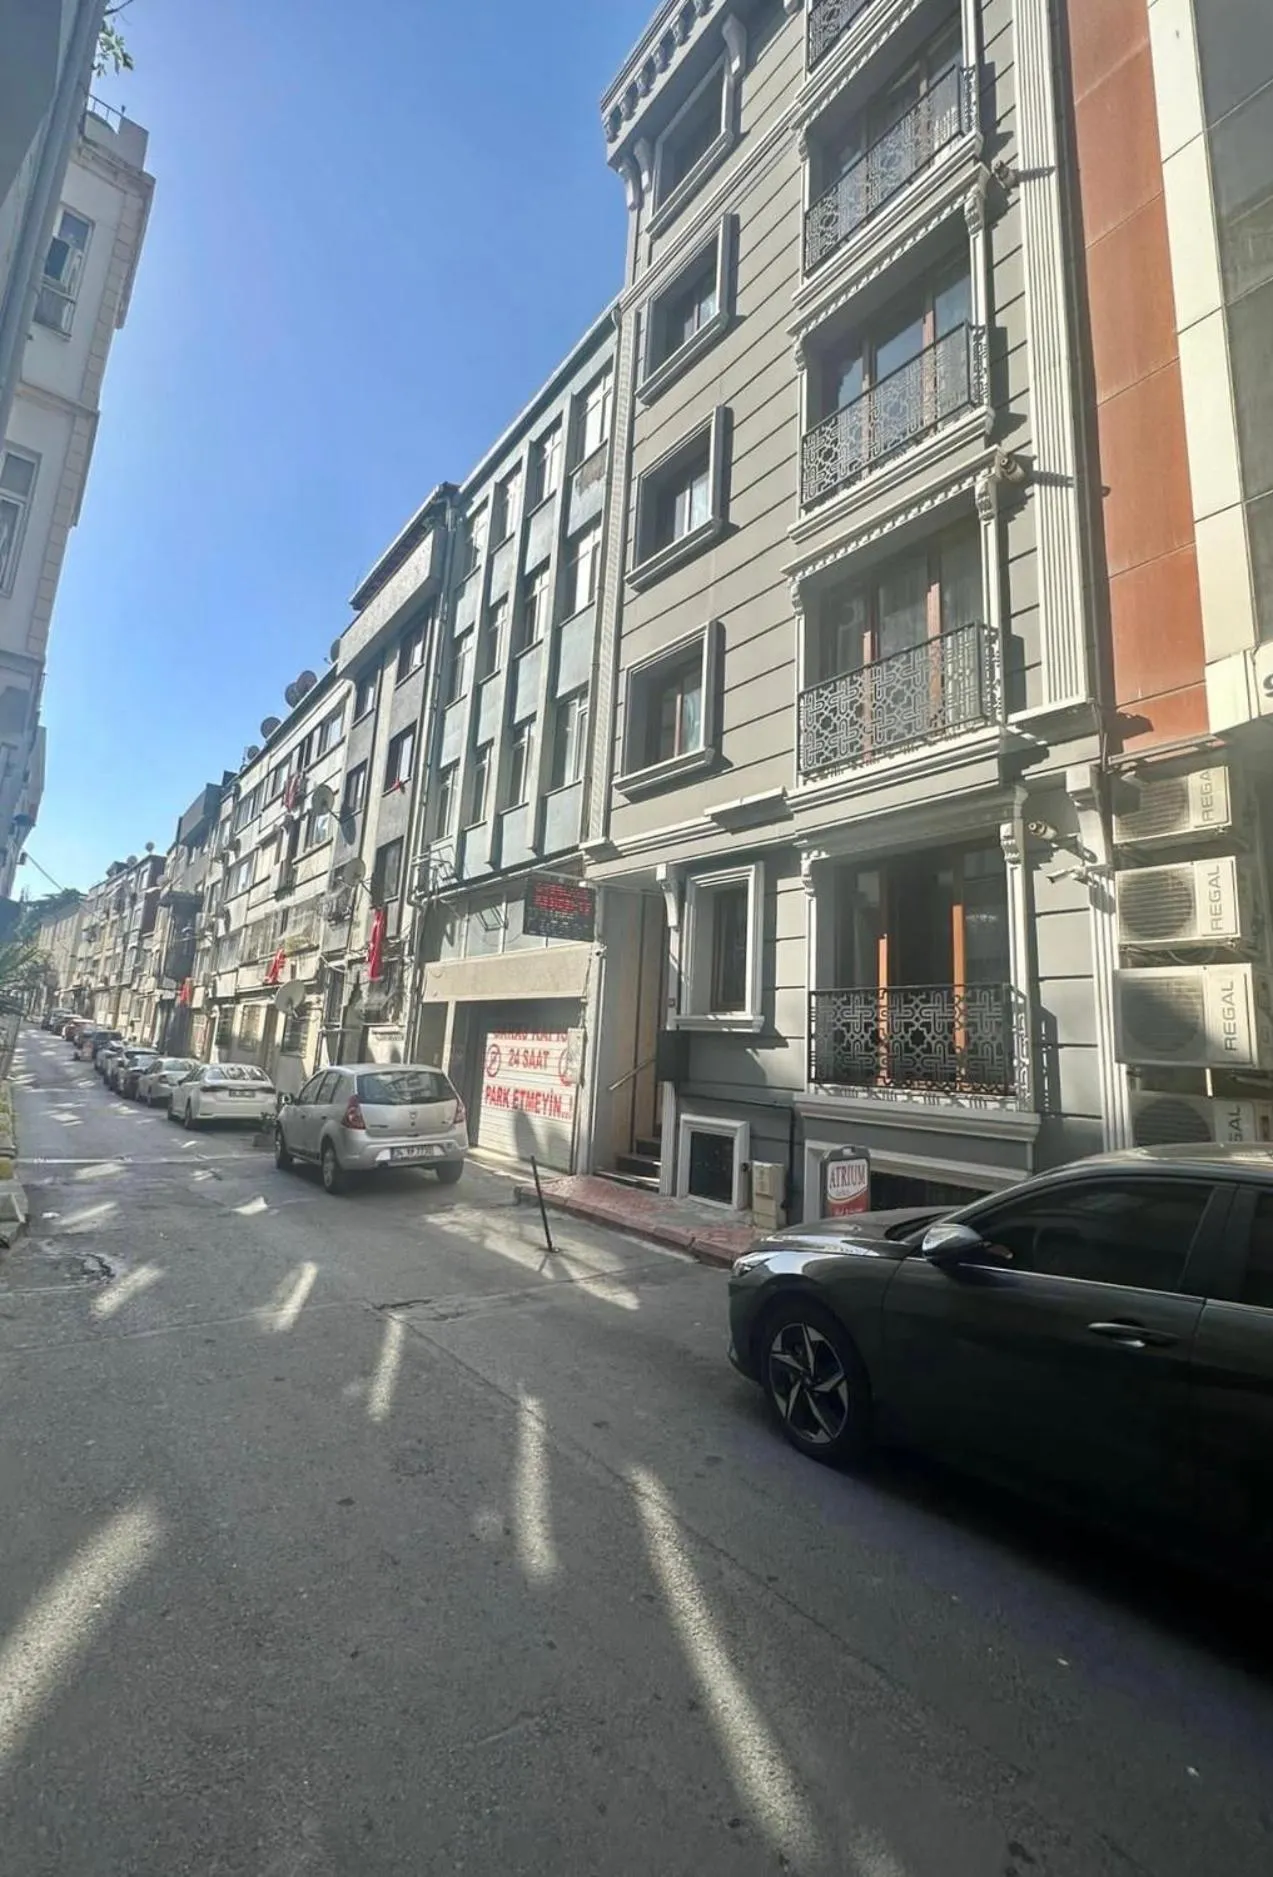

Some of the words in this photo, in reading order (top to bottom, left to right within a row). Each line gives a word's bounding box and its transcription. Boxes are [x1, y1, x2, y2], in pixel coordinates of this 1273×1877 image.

[1199, 770, 1214, 822] REGA
[1208, 864, 1223, 931] REGAL
[1221, 980, 1238, 1051] REGAL
[508, 1047, 520, 1067] 24
[522, 1047, 550, 1071] SAAT
[485, 1085, 511, 1109] PARK
[1227, 1104, 1244, 1143] GAL
[829, 1163, 866, 1189] ATRIUM
